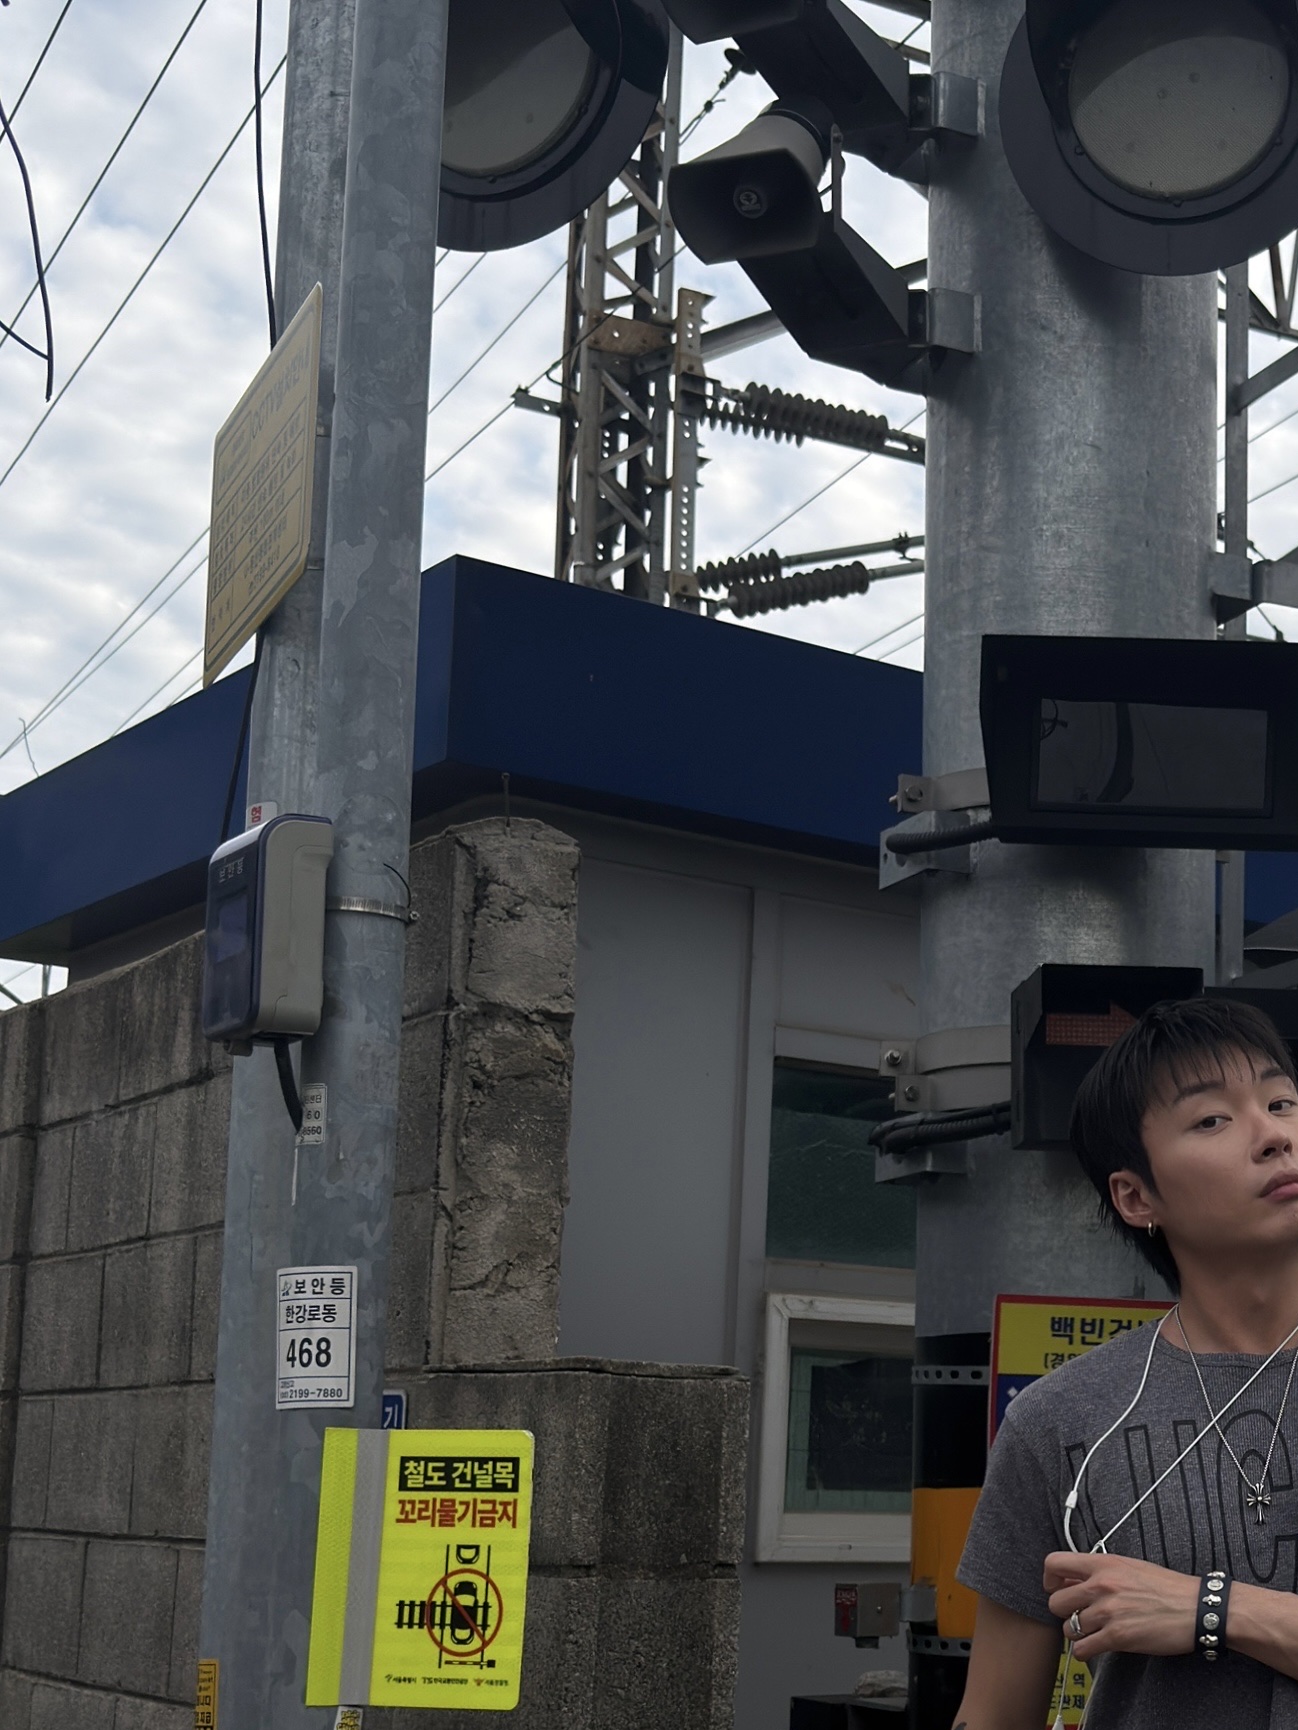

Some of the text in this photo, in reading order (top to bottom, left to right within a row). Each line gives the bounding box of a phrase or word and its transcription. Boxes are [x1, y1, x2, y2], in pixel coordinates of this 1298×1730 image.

[285, 1304, 337, 1324] 한강로동
[286, 1337, 332, 1368] 468
[404, 1460, 516, 1489] 철도 건널목
[395, 1497, 519, 1529] 꼬리물기금지
